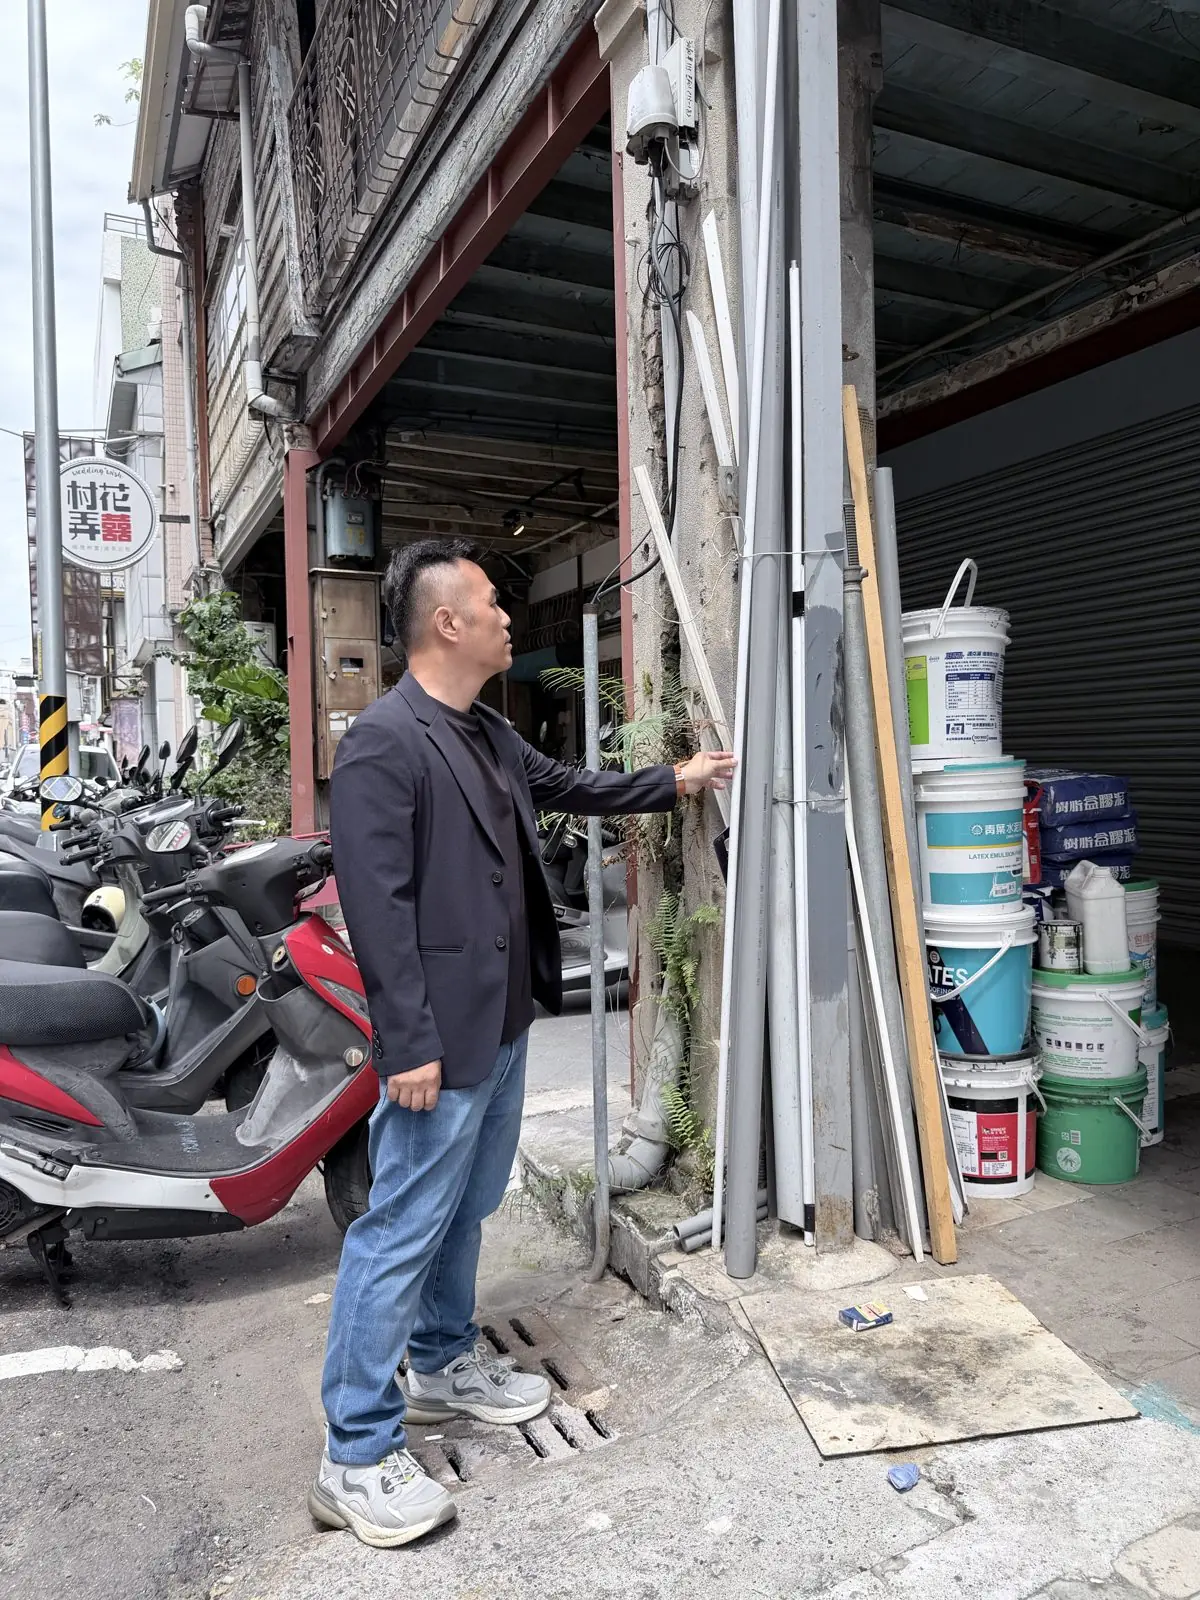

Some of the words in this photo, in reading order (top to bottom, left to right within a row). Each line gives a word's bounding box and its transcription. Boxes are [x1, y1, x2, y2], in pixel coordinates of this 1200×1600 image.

[66, 480, 131, 512] 村花
[1055, 791, 1125, 814] 樹脂益膠泥
[1063, 826, 1137, 850] 樹脂益膠泥
